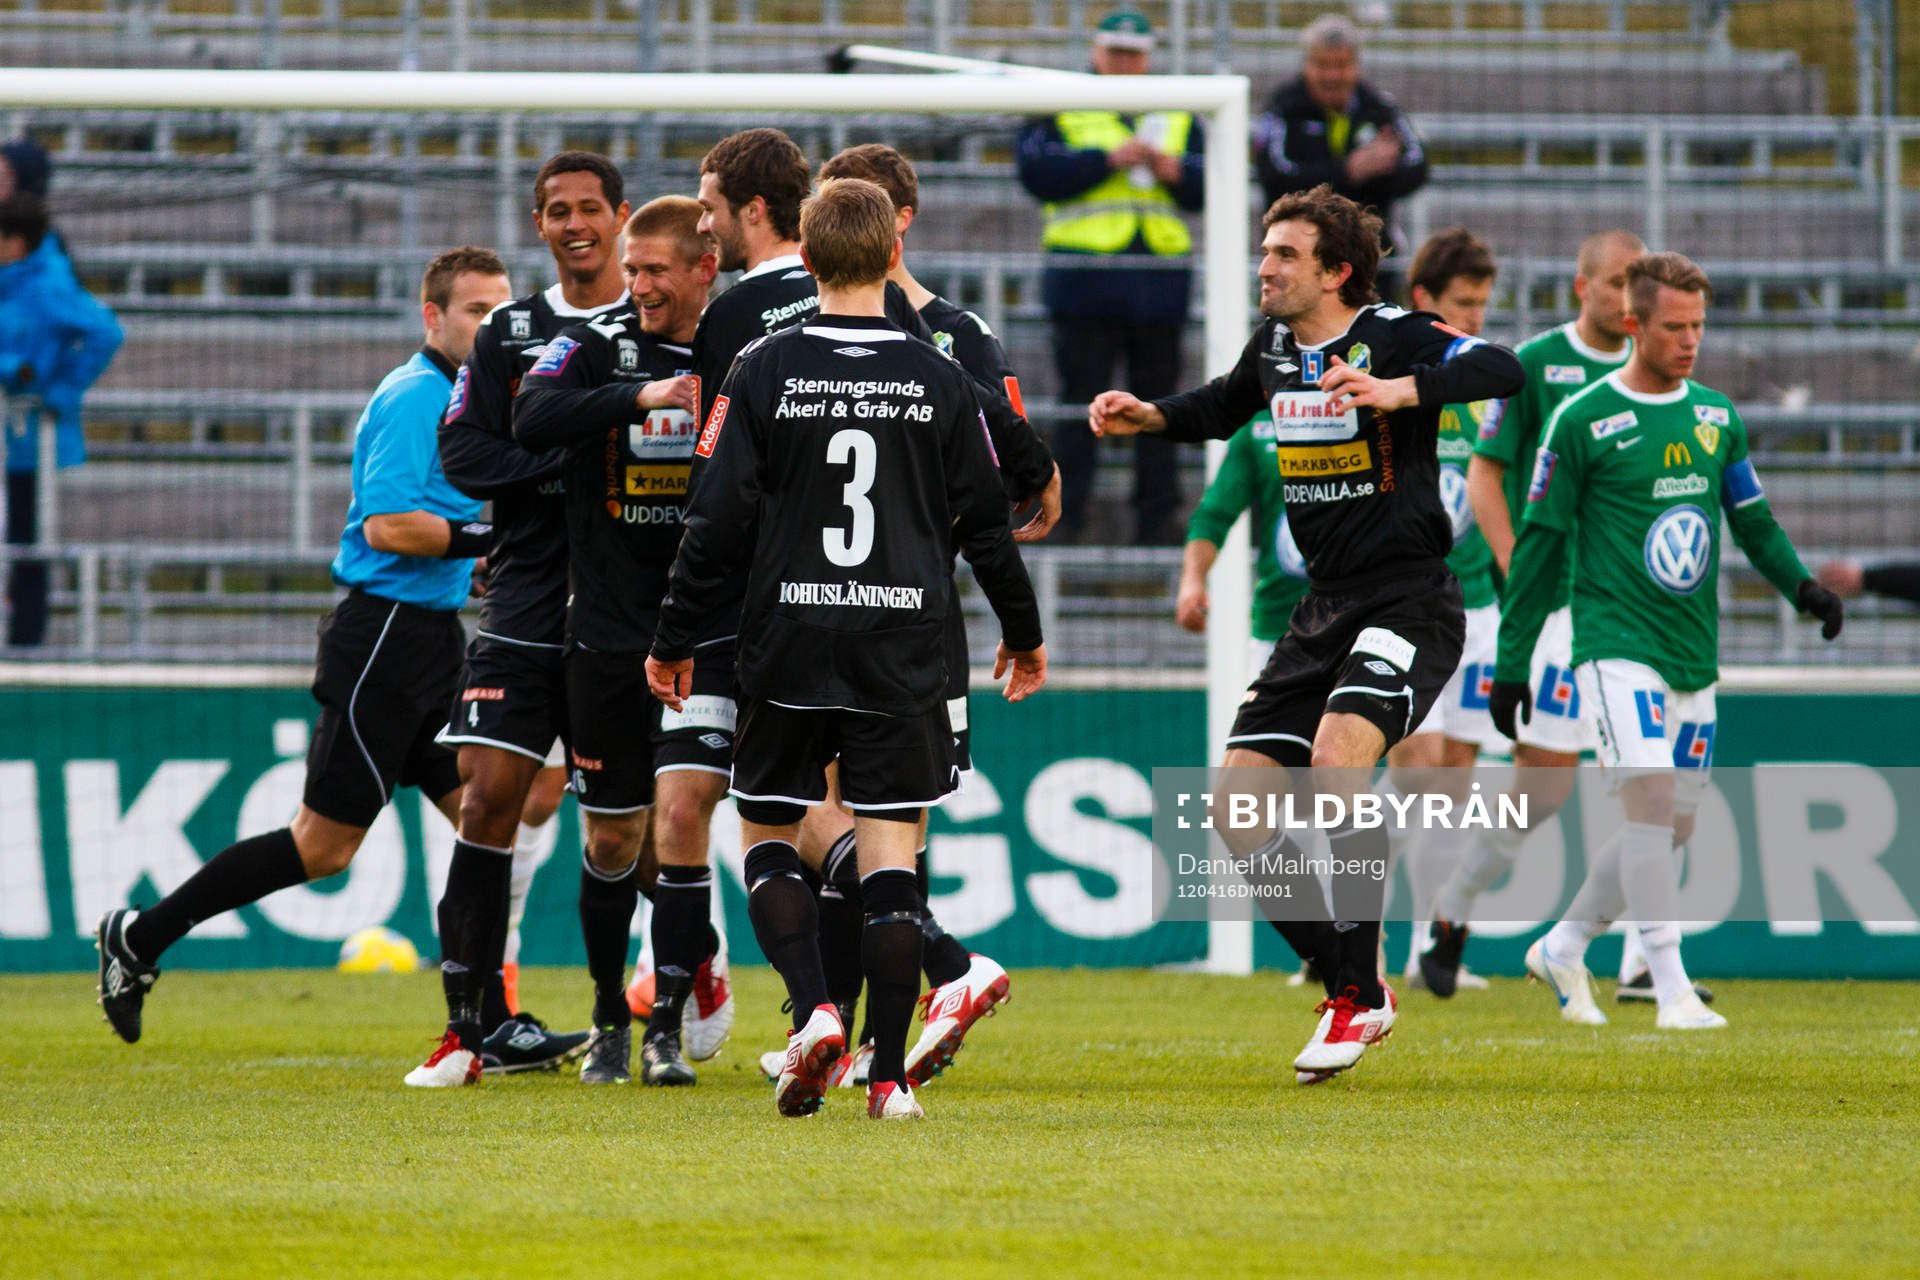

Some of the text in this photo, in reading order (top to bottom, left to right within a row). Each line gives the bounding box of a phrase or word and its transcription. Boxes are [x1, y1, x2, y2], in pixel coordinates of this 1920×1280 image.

[783, 377, 925, 399] Stenungsunds
[775, 396, 934, 423] Åkeri & Gräv AB
[700, 401, 726, 452] Adecco
[1290, 453, 1361, 472] MRKBYGG
[822, 429, 877, 567] 3
[468, 701, 480, 728] 4
